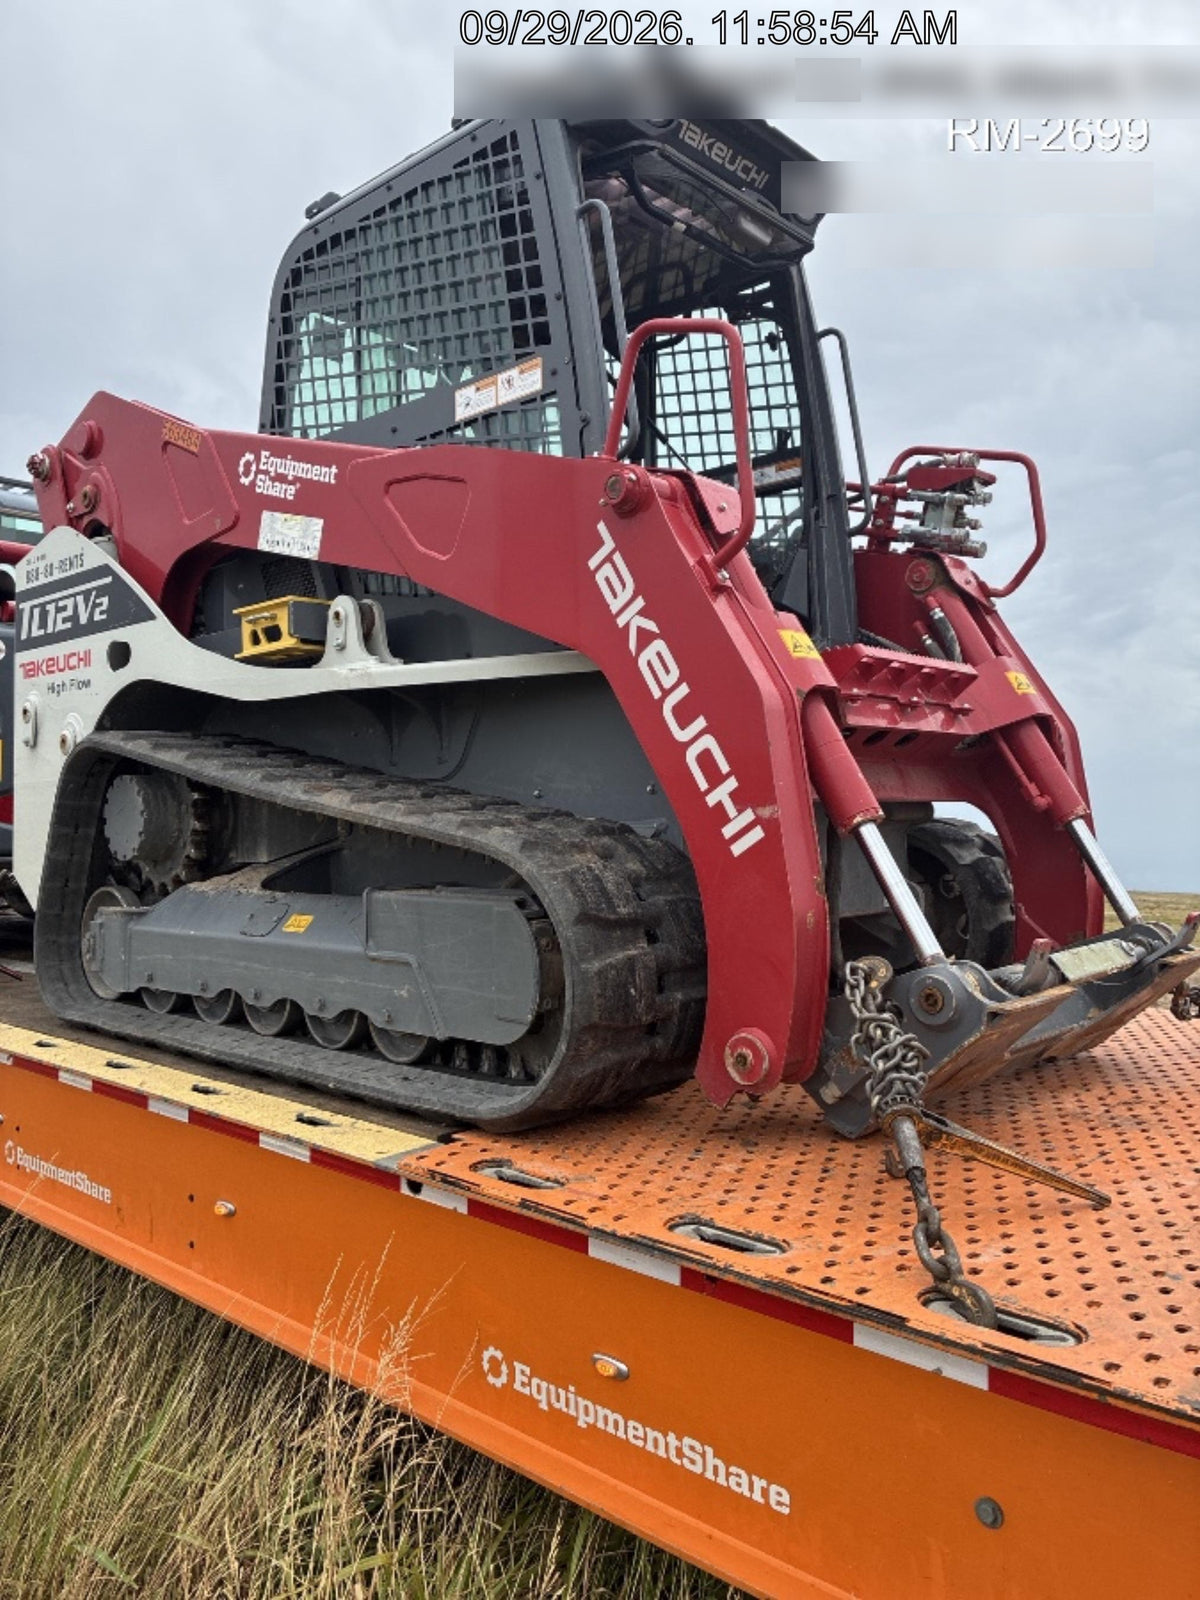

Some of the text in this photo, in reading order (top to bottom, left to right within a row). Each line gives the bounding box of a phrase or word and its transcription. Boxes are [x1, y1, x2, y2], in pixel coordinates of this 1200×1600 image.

[259, 450, 338, 484] Equipment
[255, 474, 296, 500] Share
[47, 678, 91, 697] High Flow
[17, 1146, 112, 1204] EquipmentShare
[513, 1360, 791, 1515] EquipmentShare
